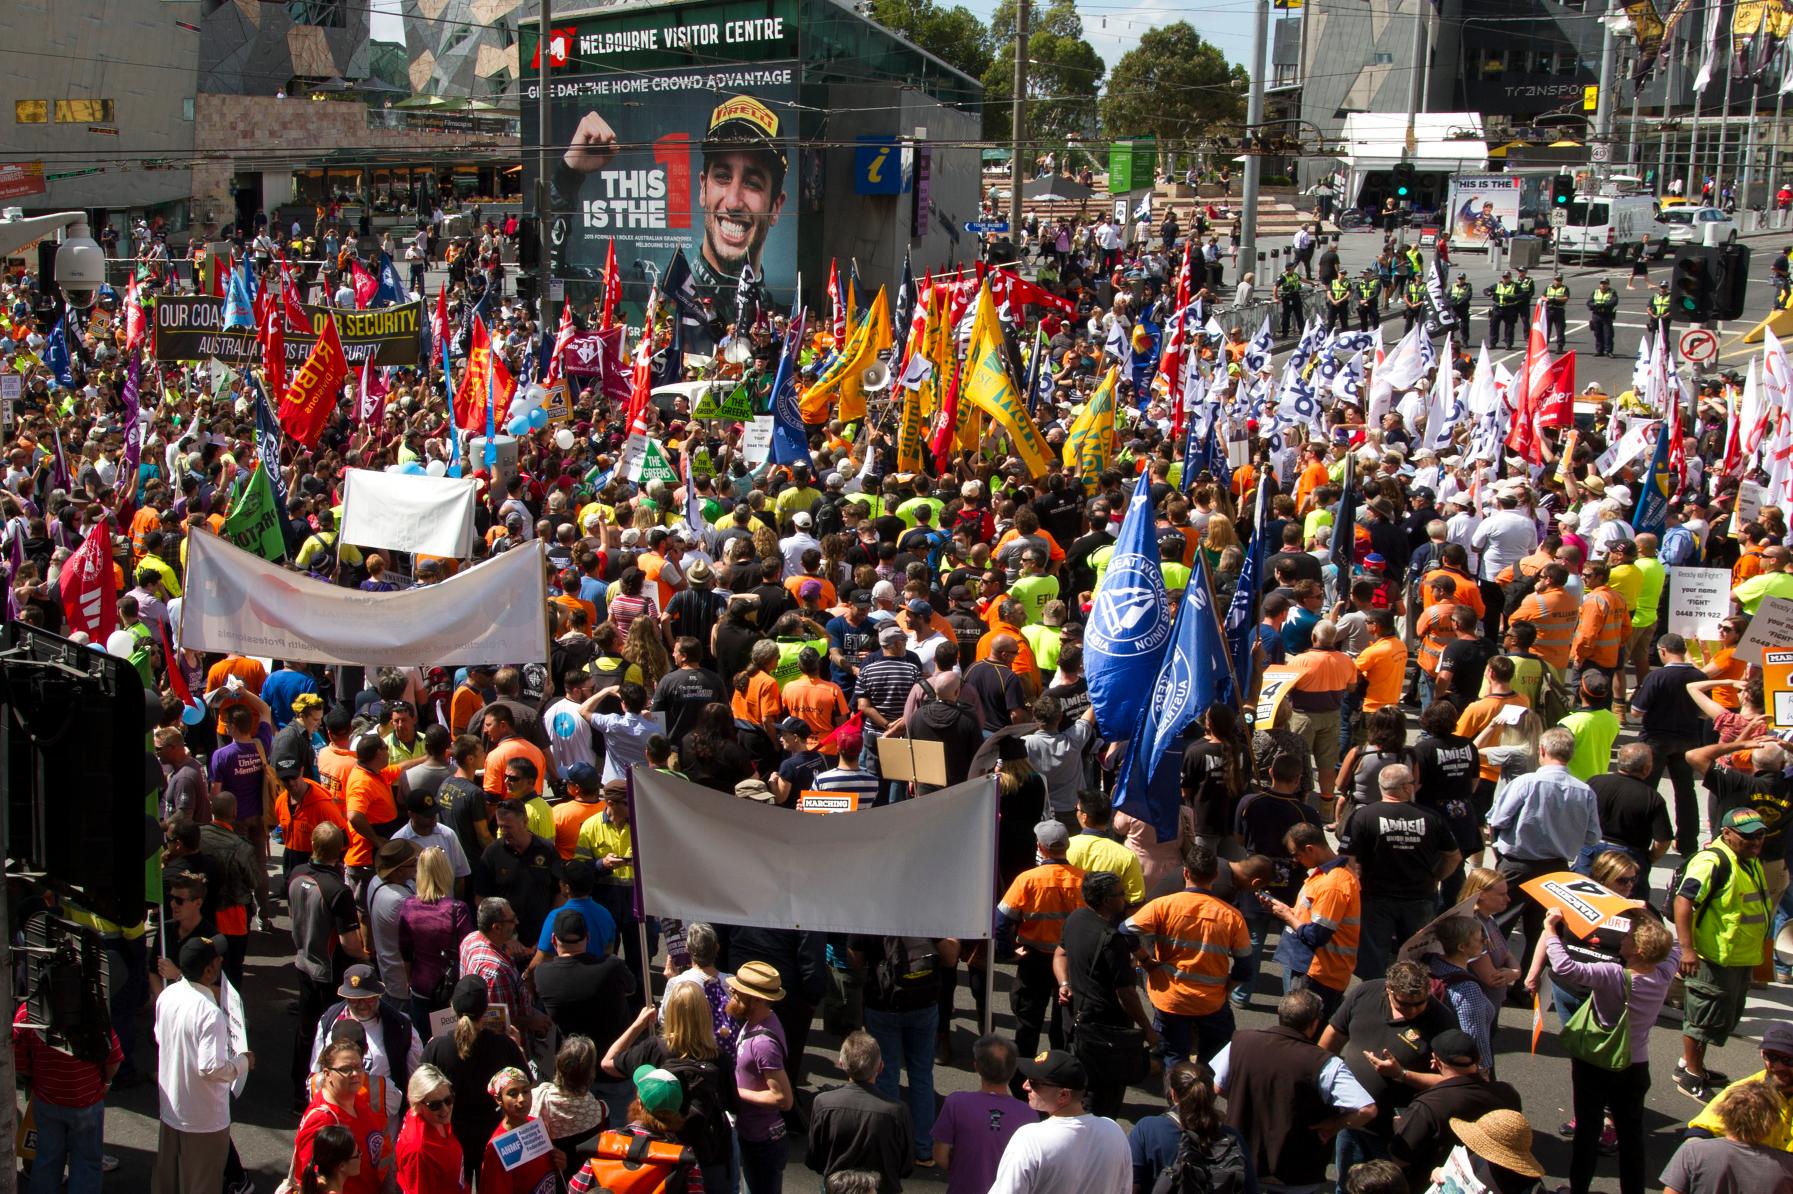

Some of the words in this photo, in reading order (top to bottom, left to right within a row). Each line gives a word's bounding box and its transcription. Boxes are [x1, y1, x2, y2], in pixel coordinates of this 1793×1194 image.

[580, 29, 658, 55] MELBOURNE
[664, 24, 719, 48] VISITOR
[726, 18, 784, 43] CENTRE
[528, 84, 555, 99] GIE
[612, 76, 650, 94] HOME
[652, 74, 703, 92] CROWD
[707, 69, 792, 88] ADVANTAGE
[717, 105, 774, 130] PIRELLI
[583, 200, 608, 229] IS
[610, 200, 666, 229] THE
[653, 132, 692, 229] 1
[601, 169, 666, 198] THIS
[1492, 180, 1512, 189] THE
[160, 304, 188, 327] OUR
[347, 308, 420, 336] SECURITY.
[199, 336, 258, 357] AUSTRALIA
[722, 407, 750, 419] GREENS
[731, 398, 745, 408] THE
[647, 455, 662, 467] THE
[642, 467, 671, 479] GREENS
[1681, 587, 1696, 595] your
[1261, 680, 1284, 701] 4
[1436, 744, 1473, 765] AMIEU
[805, 797, 849, 810] MARCHING
[1378, 815, 1426, 836] AMIEU
[1545, 881, 1601, 922] MARCHING
[500, 1140, 523, 1158] ANMF
